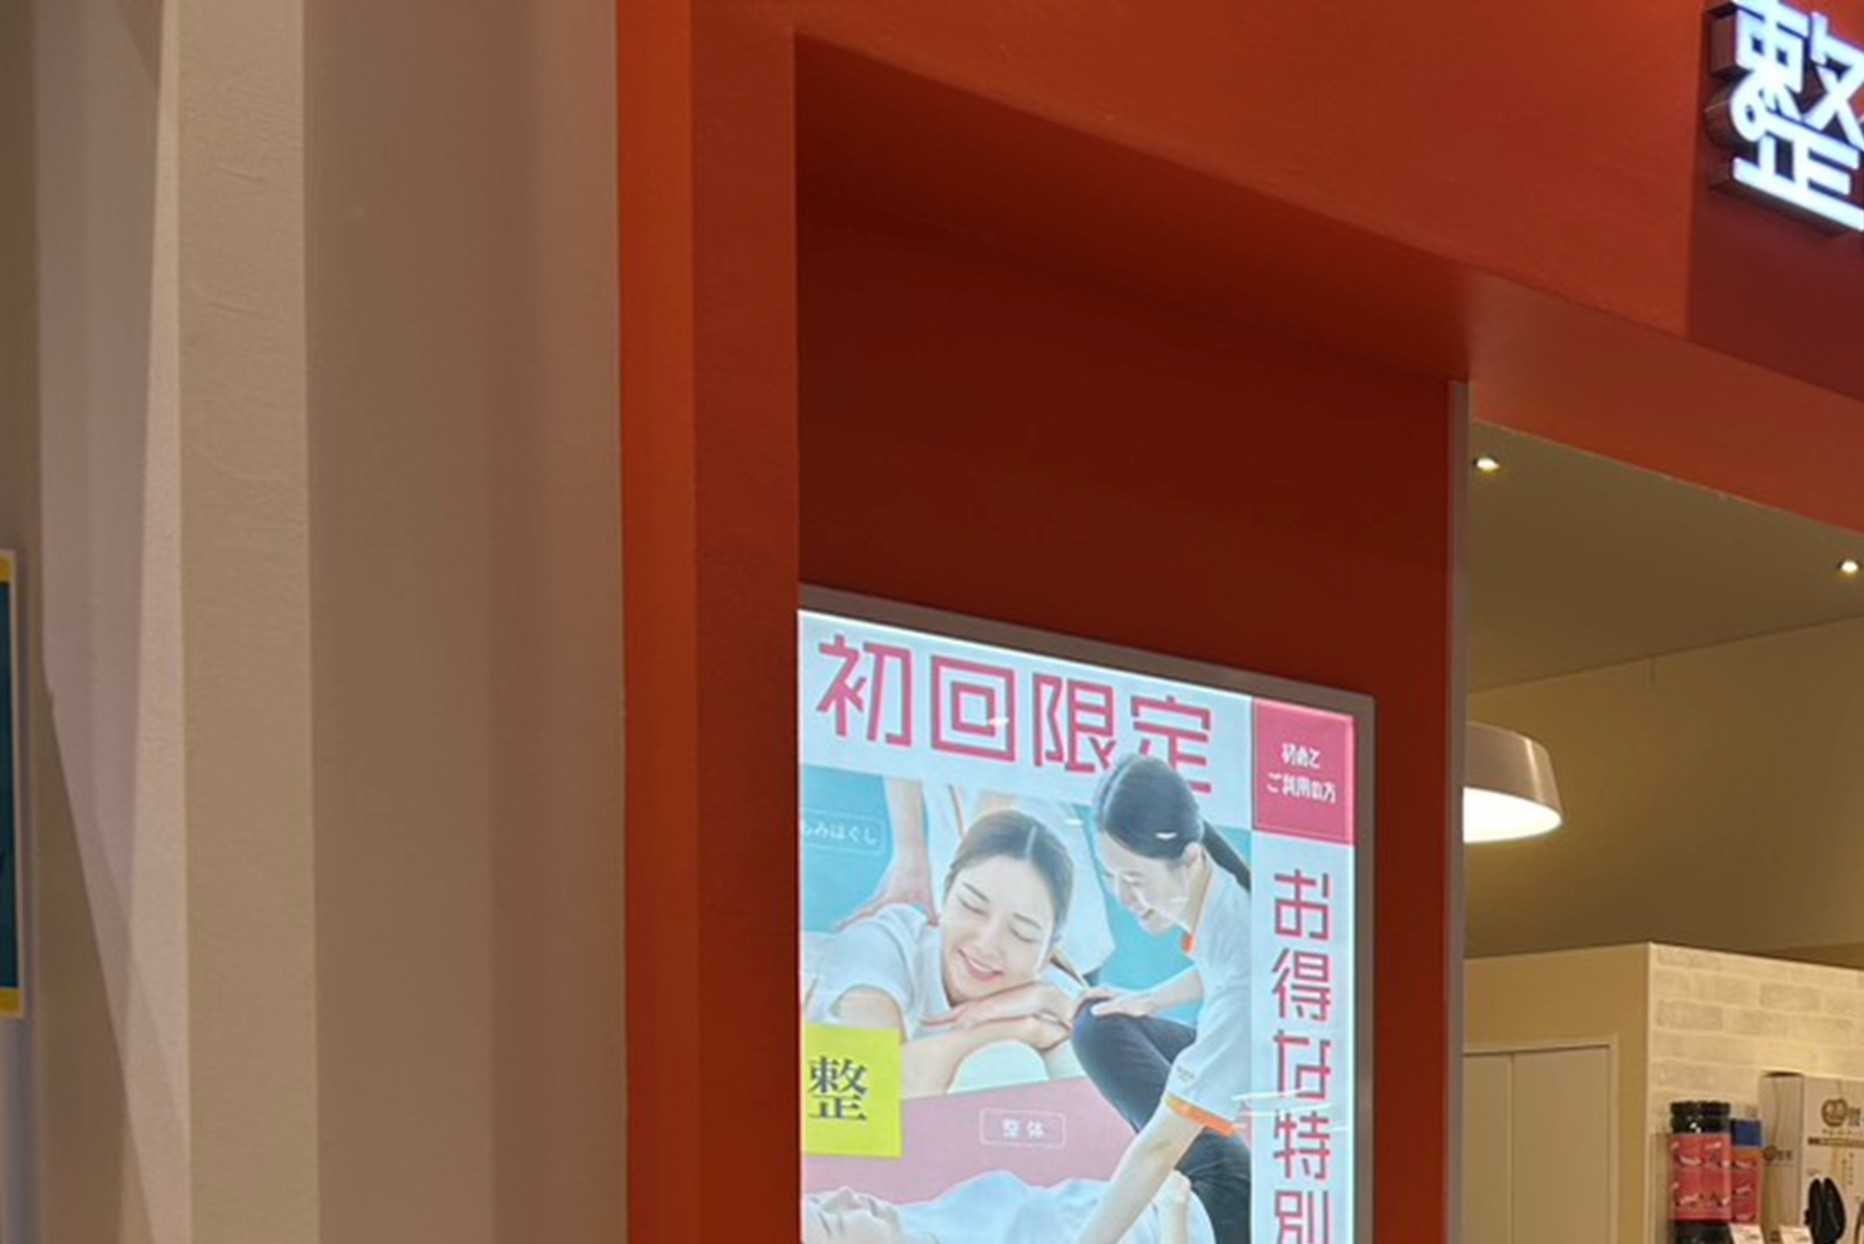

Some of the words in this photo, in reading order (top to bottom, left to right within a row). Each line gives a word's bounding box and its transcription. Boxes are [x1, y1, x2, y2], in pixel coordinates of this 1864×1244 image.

[816, 634, 1212, 796] 初回限定
[809, 1056, 868, 1122] 整
